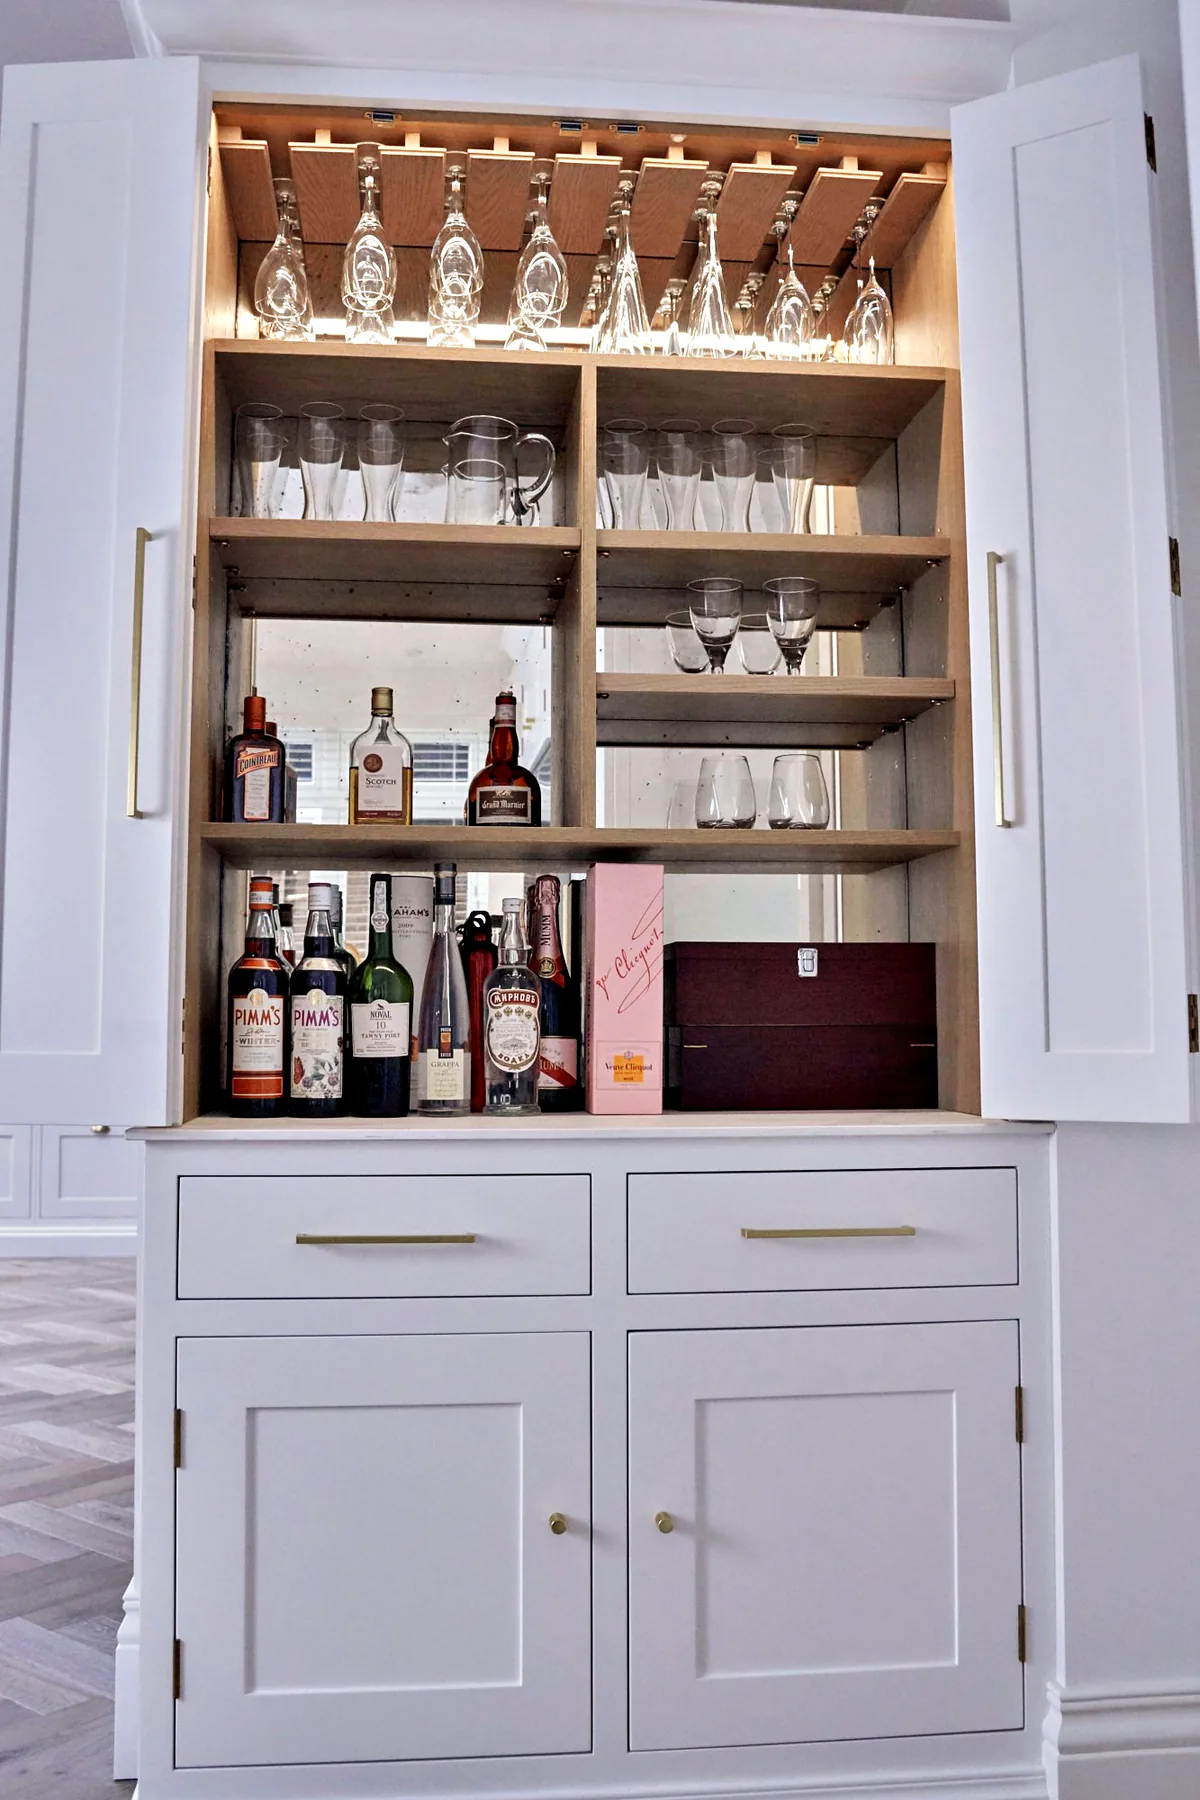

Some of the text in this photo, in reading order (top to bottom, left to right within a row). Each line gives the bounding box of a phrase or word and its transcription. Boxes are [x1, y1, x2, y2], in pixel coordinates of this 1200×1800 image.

[240, 753, 277, 773] COINTREAU
[481, 800, 526, 809] Grand Marnier
[393, 908, 430, 917] AHAM'S
[540, 914, 551, 946] MUMM
[235, 1005, 281, 1026] PIMM'S
[294, 1006, 340, 1027] PIMM'S
[370, 1010, 392, 1019] NOVAL
[376, 1021, 387, 1030] 10
[239, 1037, 277, 1045] WINTER
[540, 1060, 564, 1071] UMM
[605, 1062, 653, 1072] Veuve Clicquot
